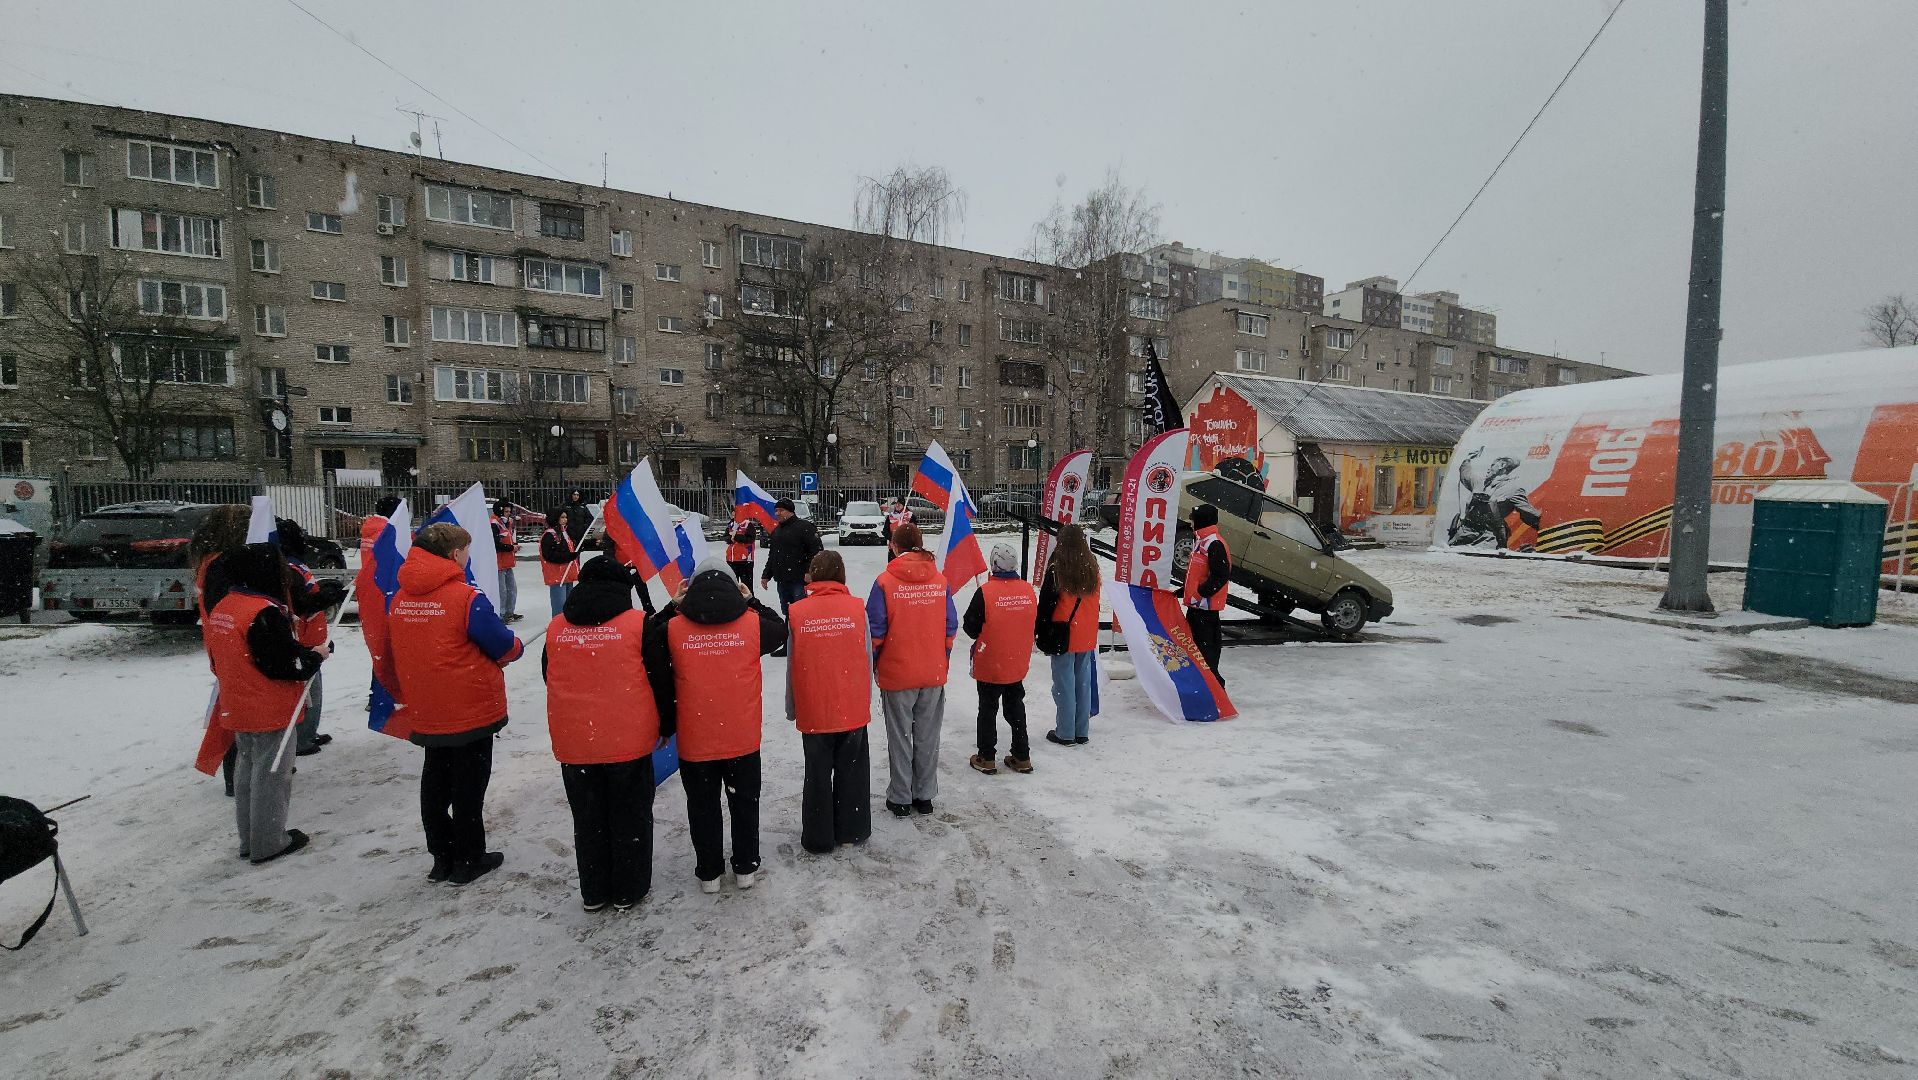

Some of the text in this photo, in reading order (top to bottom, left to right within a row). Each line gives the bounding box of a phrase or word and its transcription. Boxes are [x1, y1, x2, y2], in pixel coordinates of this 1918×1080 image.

[1406, 448, 1454, 465] МОТО
[1712, 440, 1779, 476] 80
[804, 475, 814, 489] P
[1123, 478, 1137, 524] 215-21-21
[1123, 525, 1132, 542] 495
[682, 640, 745, 650] ПОДМОСКОВЬЯ
[688, 633, 740, 642] ВОЛОНТЕРЫ
